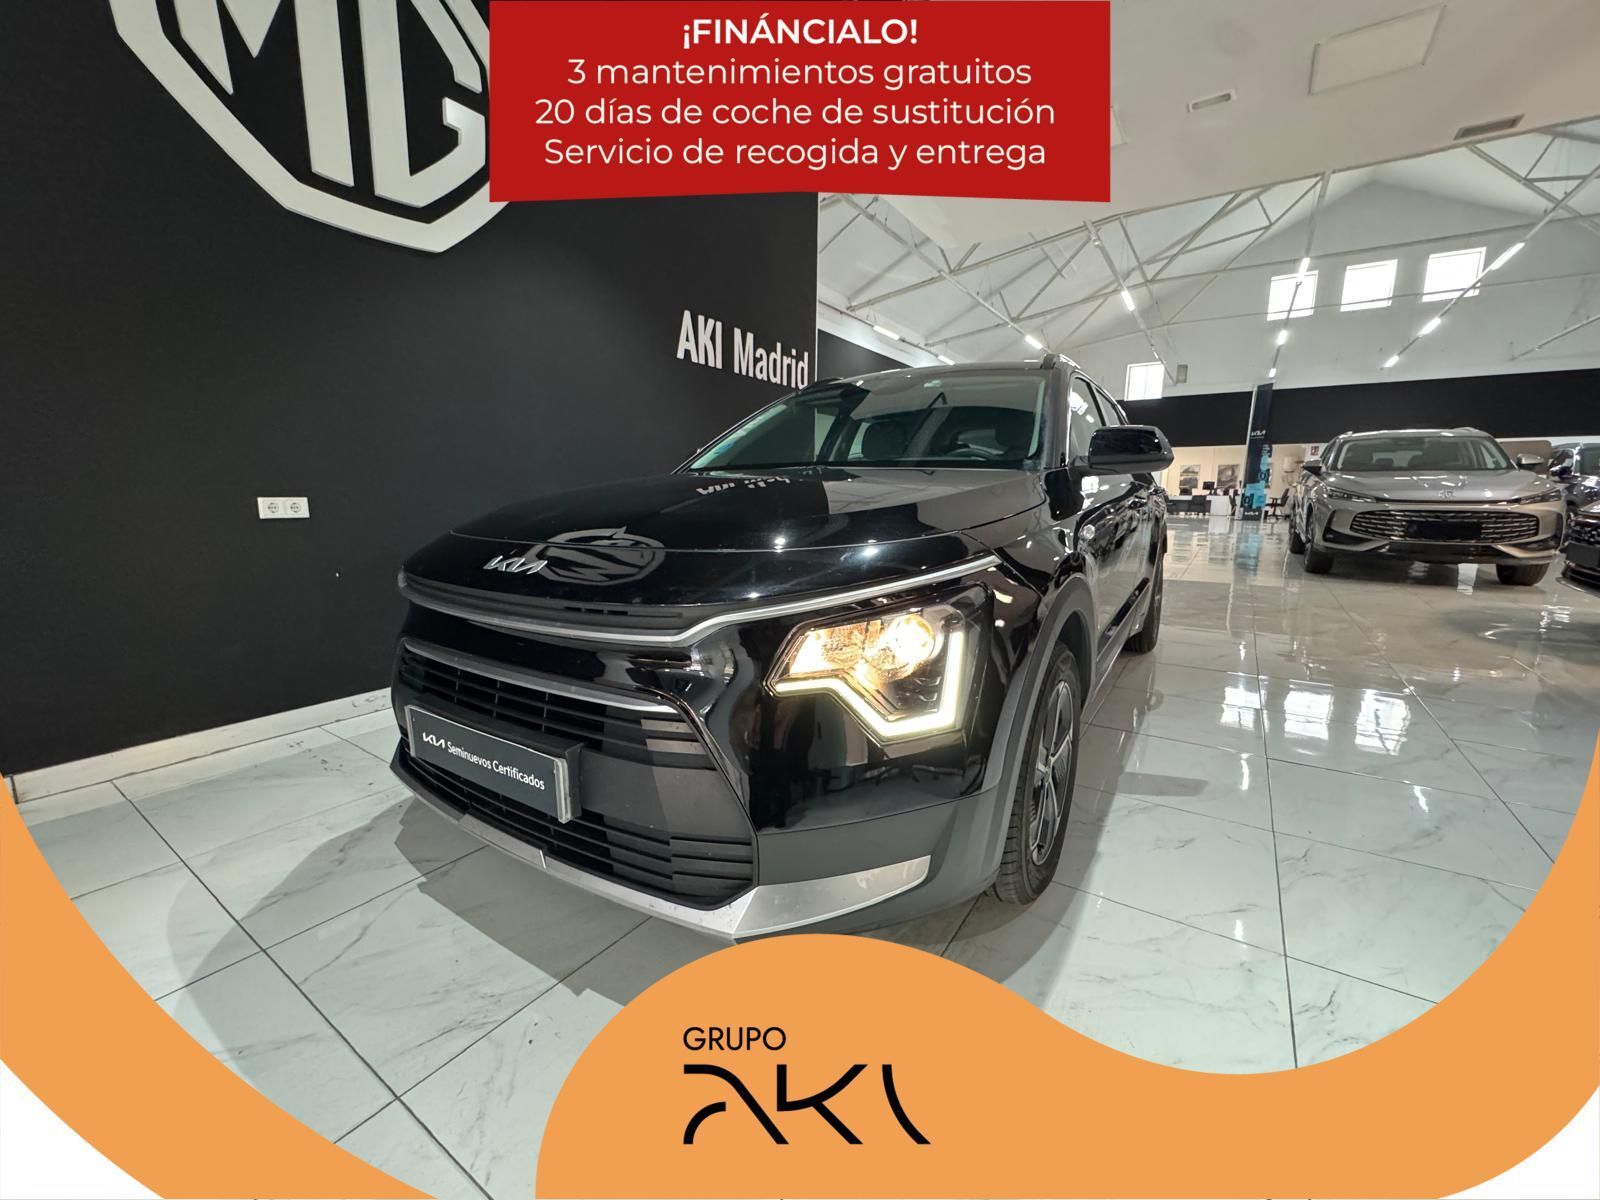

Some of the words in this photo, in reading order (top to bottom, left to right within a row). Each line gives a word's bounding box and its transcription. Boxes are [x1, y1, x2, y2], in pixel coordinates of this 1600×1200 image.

[676, 309, 723, 369] AKI
[733, 327, 809, 390] Madrid
[483, 555, 548, 575] KIA
[422, 732, 446, 749] KIA
[447, 741, 492, 770] Seminuevos
[492, 760, 545, 791] Certificados
